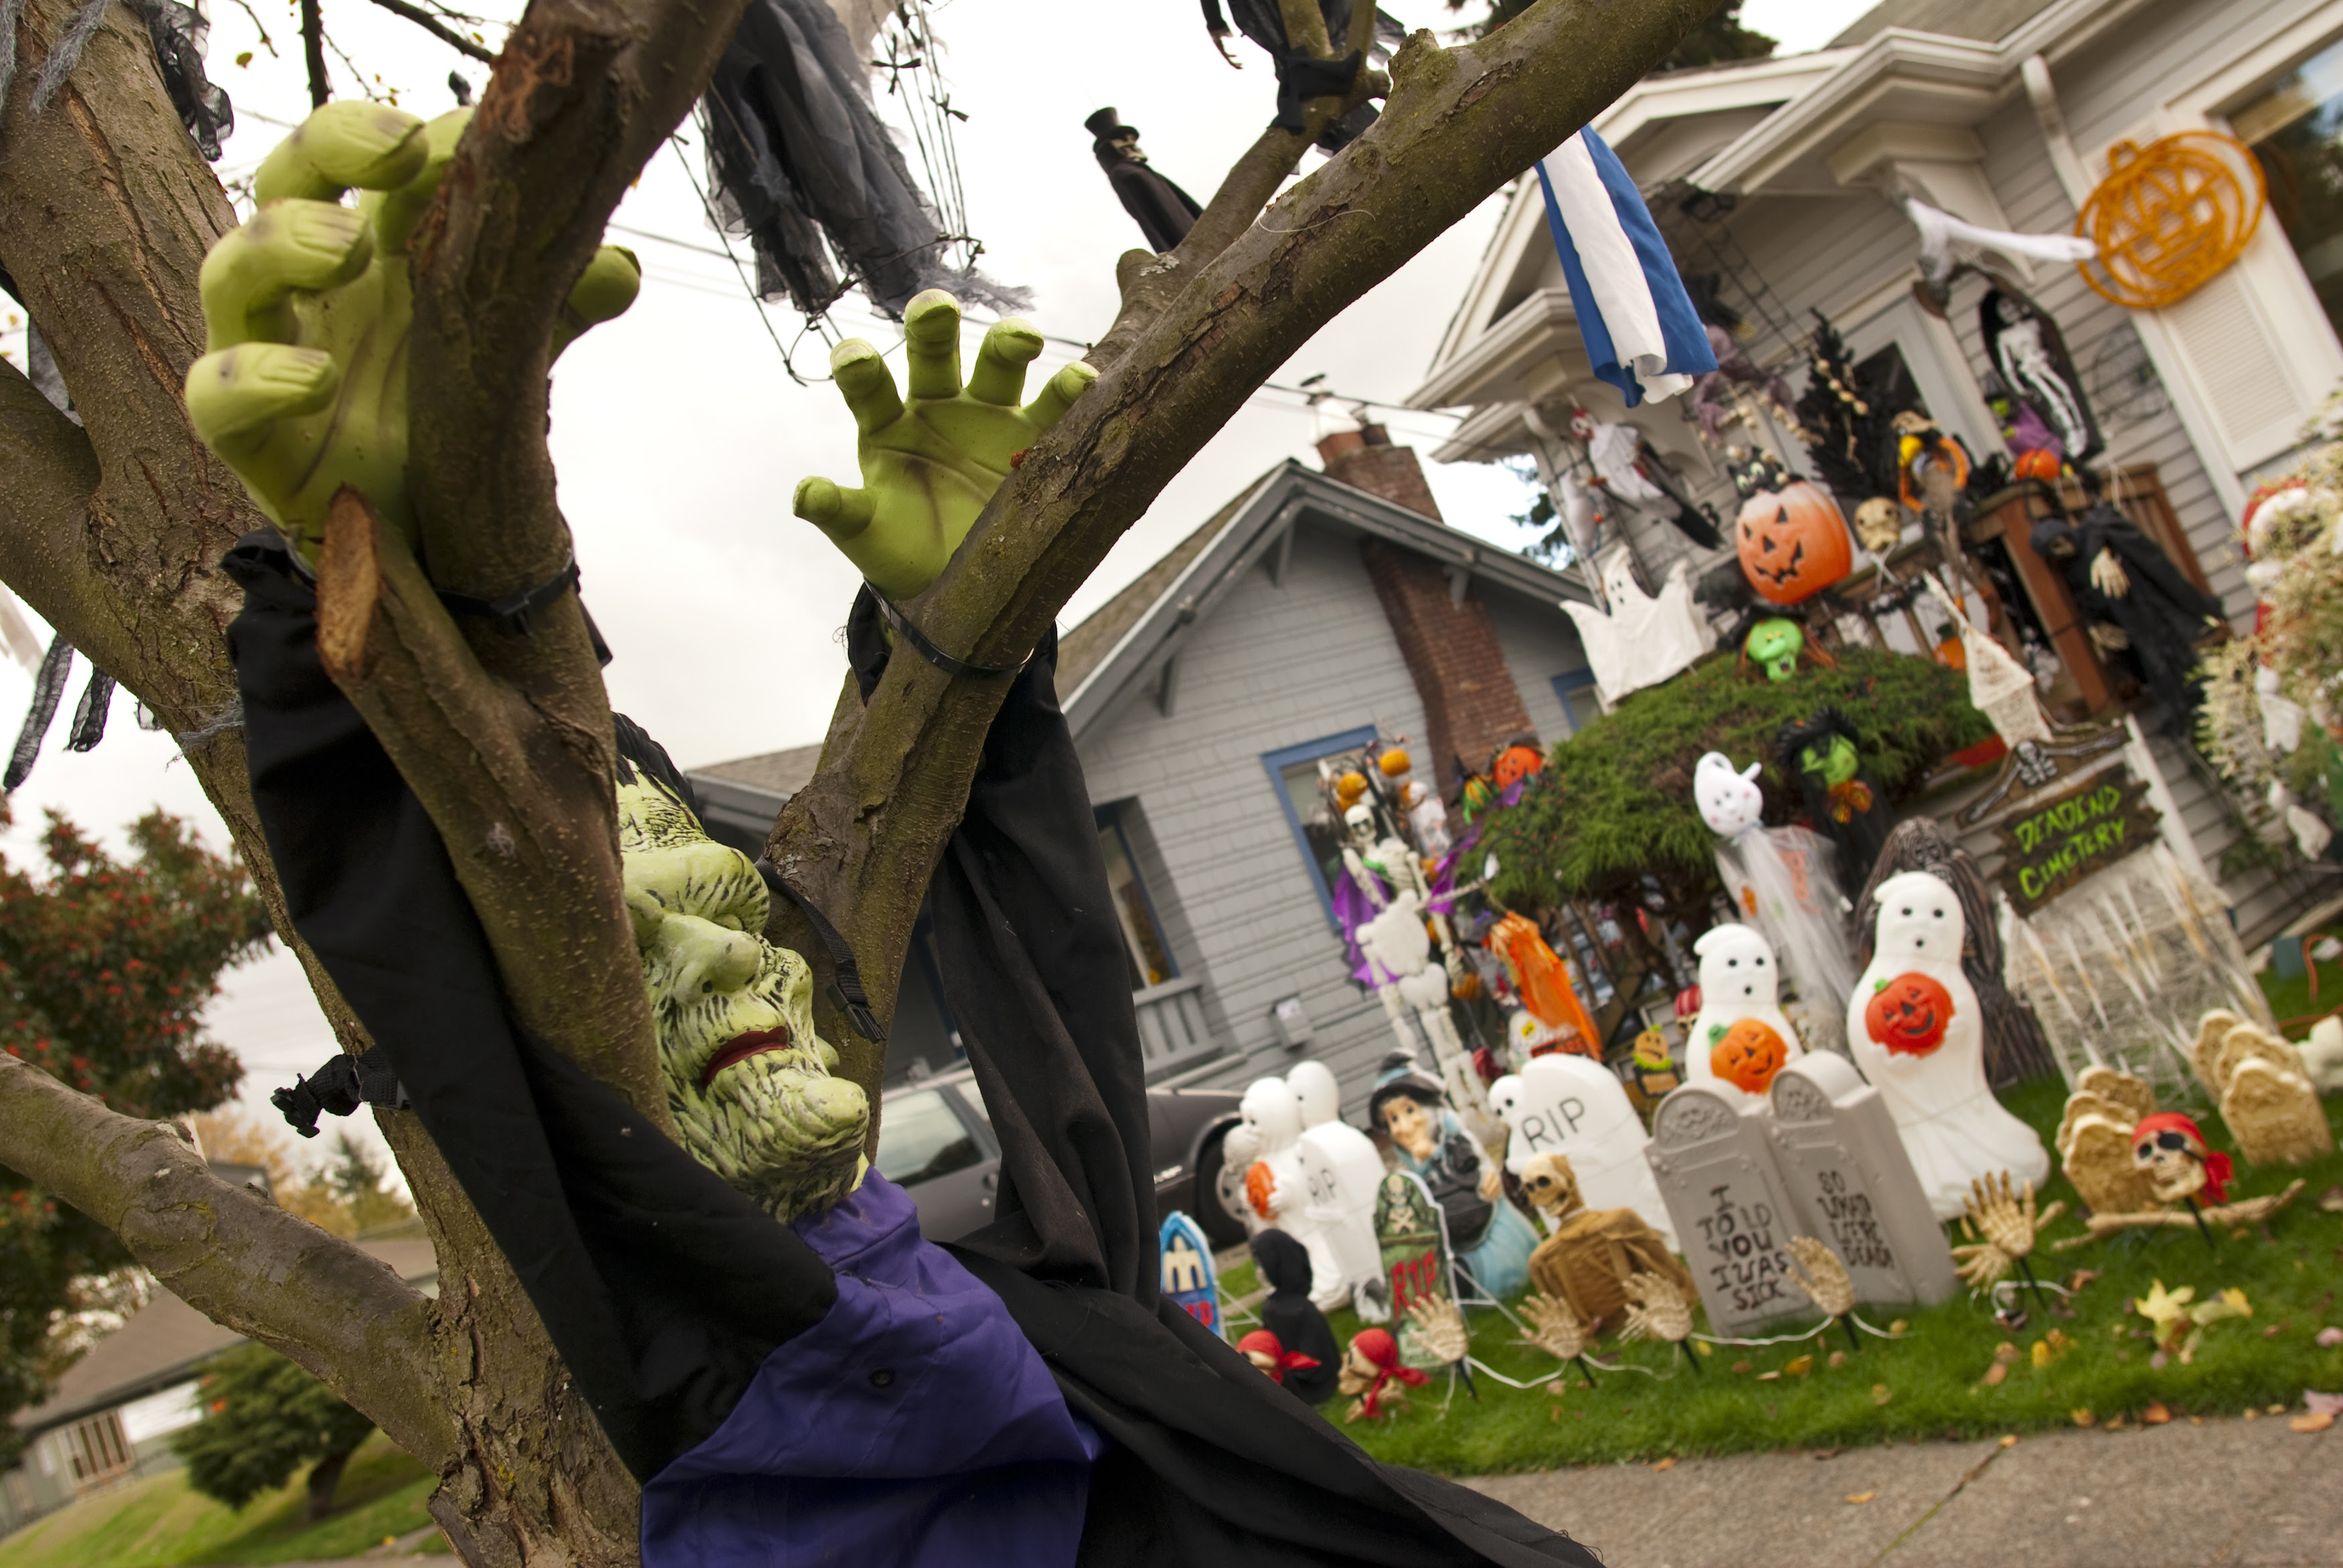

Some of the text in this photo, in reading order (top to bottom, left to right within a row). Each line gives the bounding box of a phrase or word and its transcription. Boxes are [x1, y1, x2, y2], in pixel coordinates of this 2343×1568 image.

[1520, 1097, 1585, 1152] RIP
[1307, 1168, 1337, 1207] RIP
[1710, 1183, 1735, 1214] I
[1696, 1202, 1773, 1241] TOLD
[1708, 1229, 1773, 1261] YOU
[1392, 1250, 1437, 1328] RIP
[1710, 1250, 1789, 1293] I WAS
[1732, 1278, 1786, 1311] SICK
